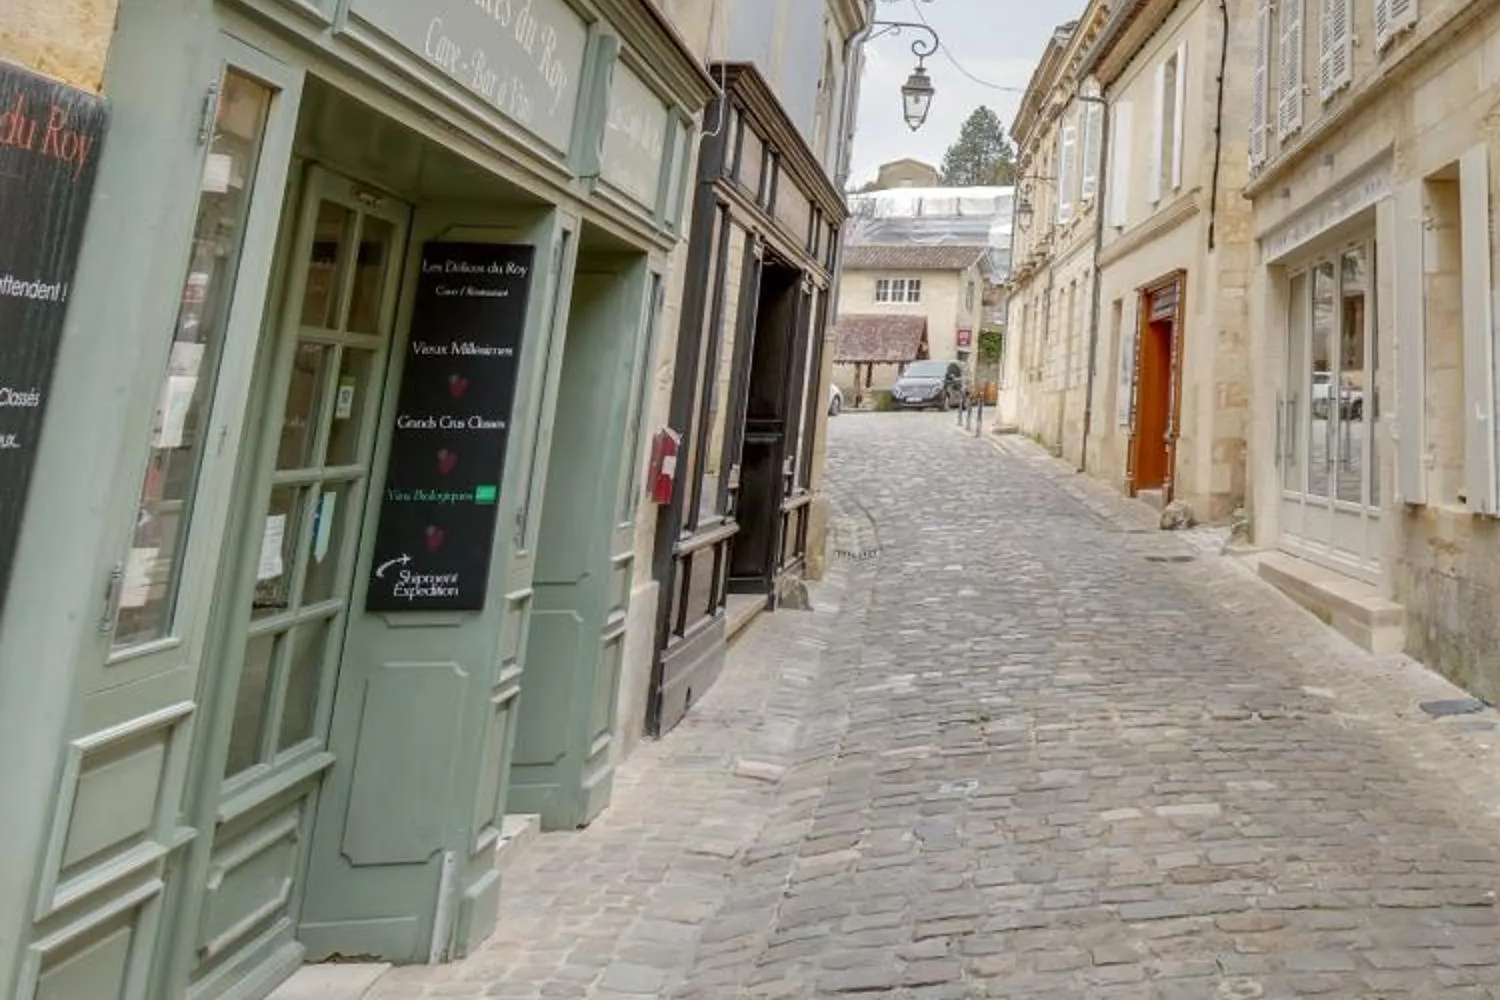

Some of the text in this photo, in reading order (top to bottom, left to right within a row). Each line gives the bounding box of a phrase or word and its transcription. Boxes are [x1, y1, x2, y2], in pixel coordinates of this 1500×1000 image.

[425, 16, 462, 73] Cave
[471, 49, 497, 97] Bar
[538, 24, 568, 115] Roy
[0, 94, 94, 182] du Roy
[504, 261, 528, 278] Roy
[397, 415, 437, 429] Grands
[439, 415, 465, 429] Crus
[399, 569, 459, 584] Shipment
